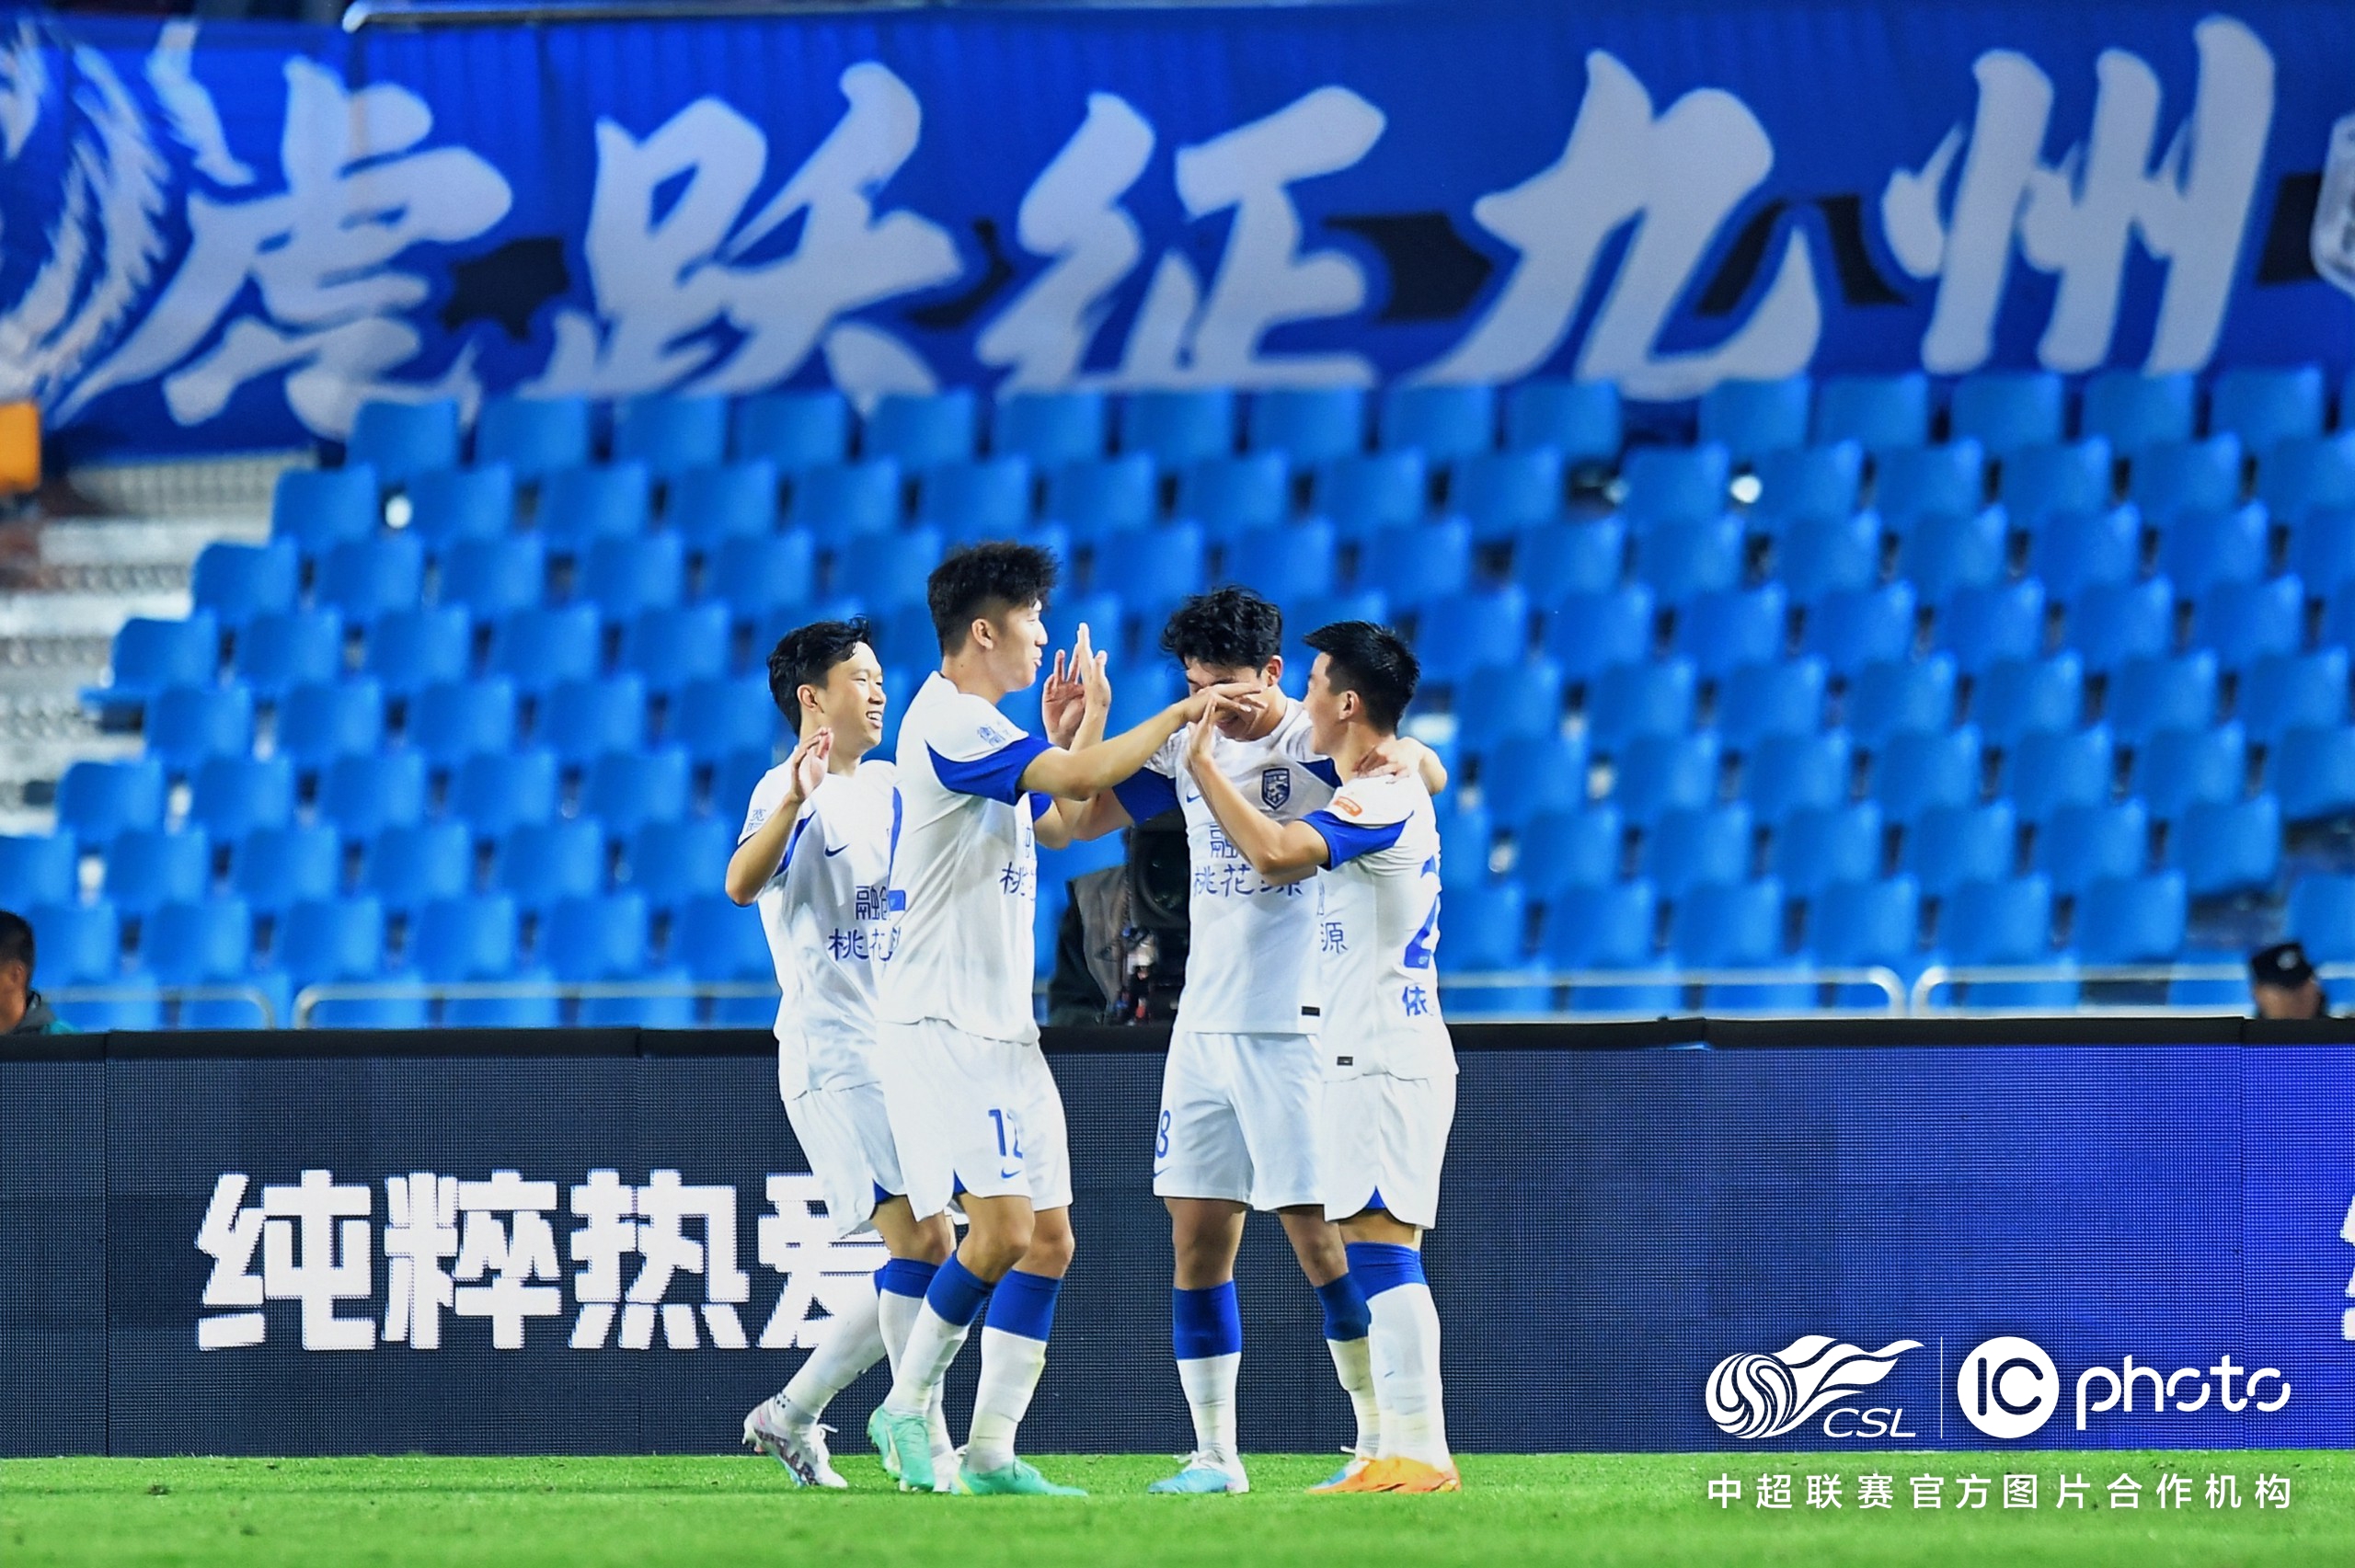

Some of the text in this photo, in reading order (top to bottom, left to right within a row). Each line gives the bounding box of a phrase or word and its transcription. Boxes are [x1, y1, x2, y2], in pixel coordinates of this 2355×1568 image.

[46, 16, 2275, 439] 虎跃征九州
